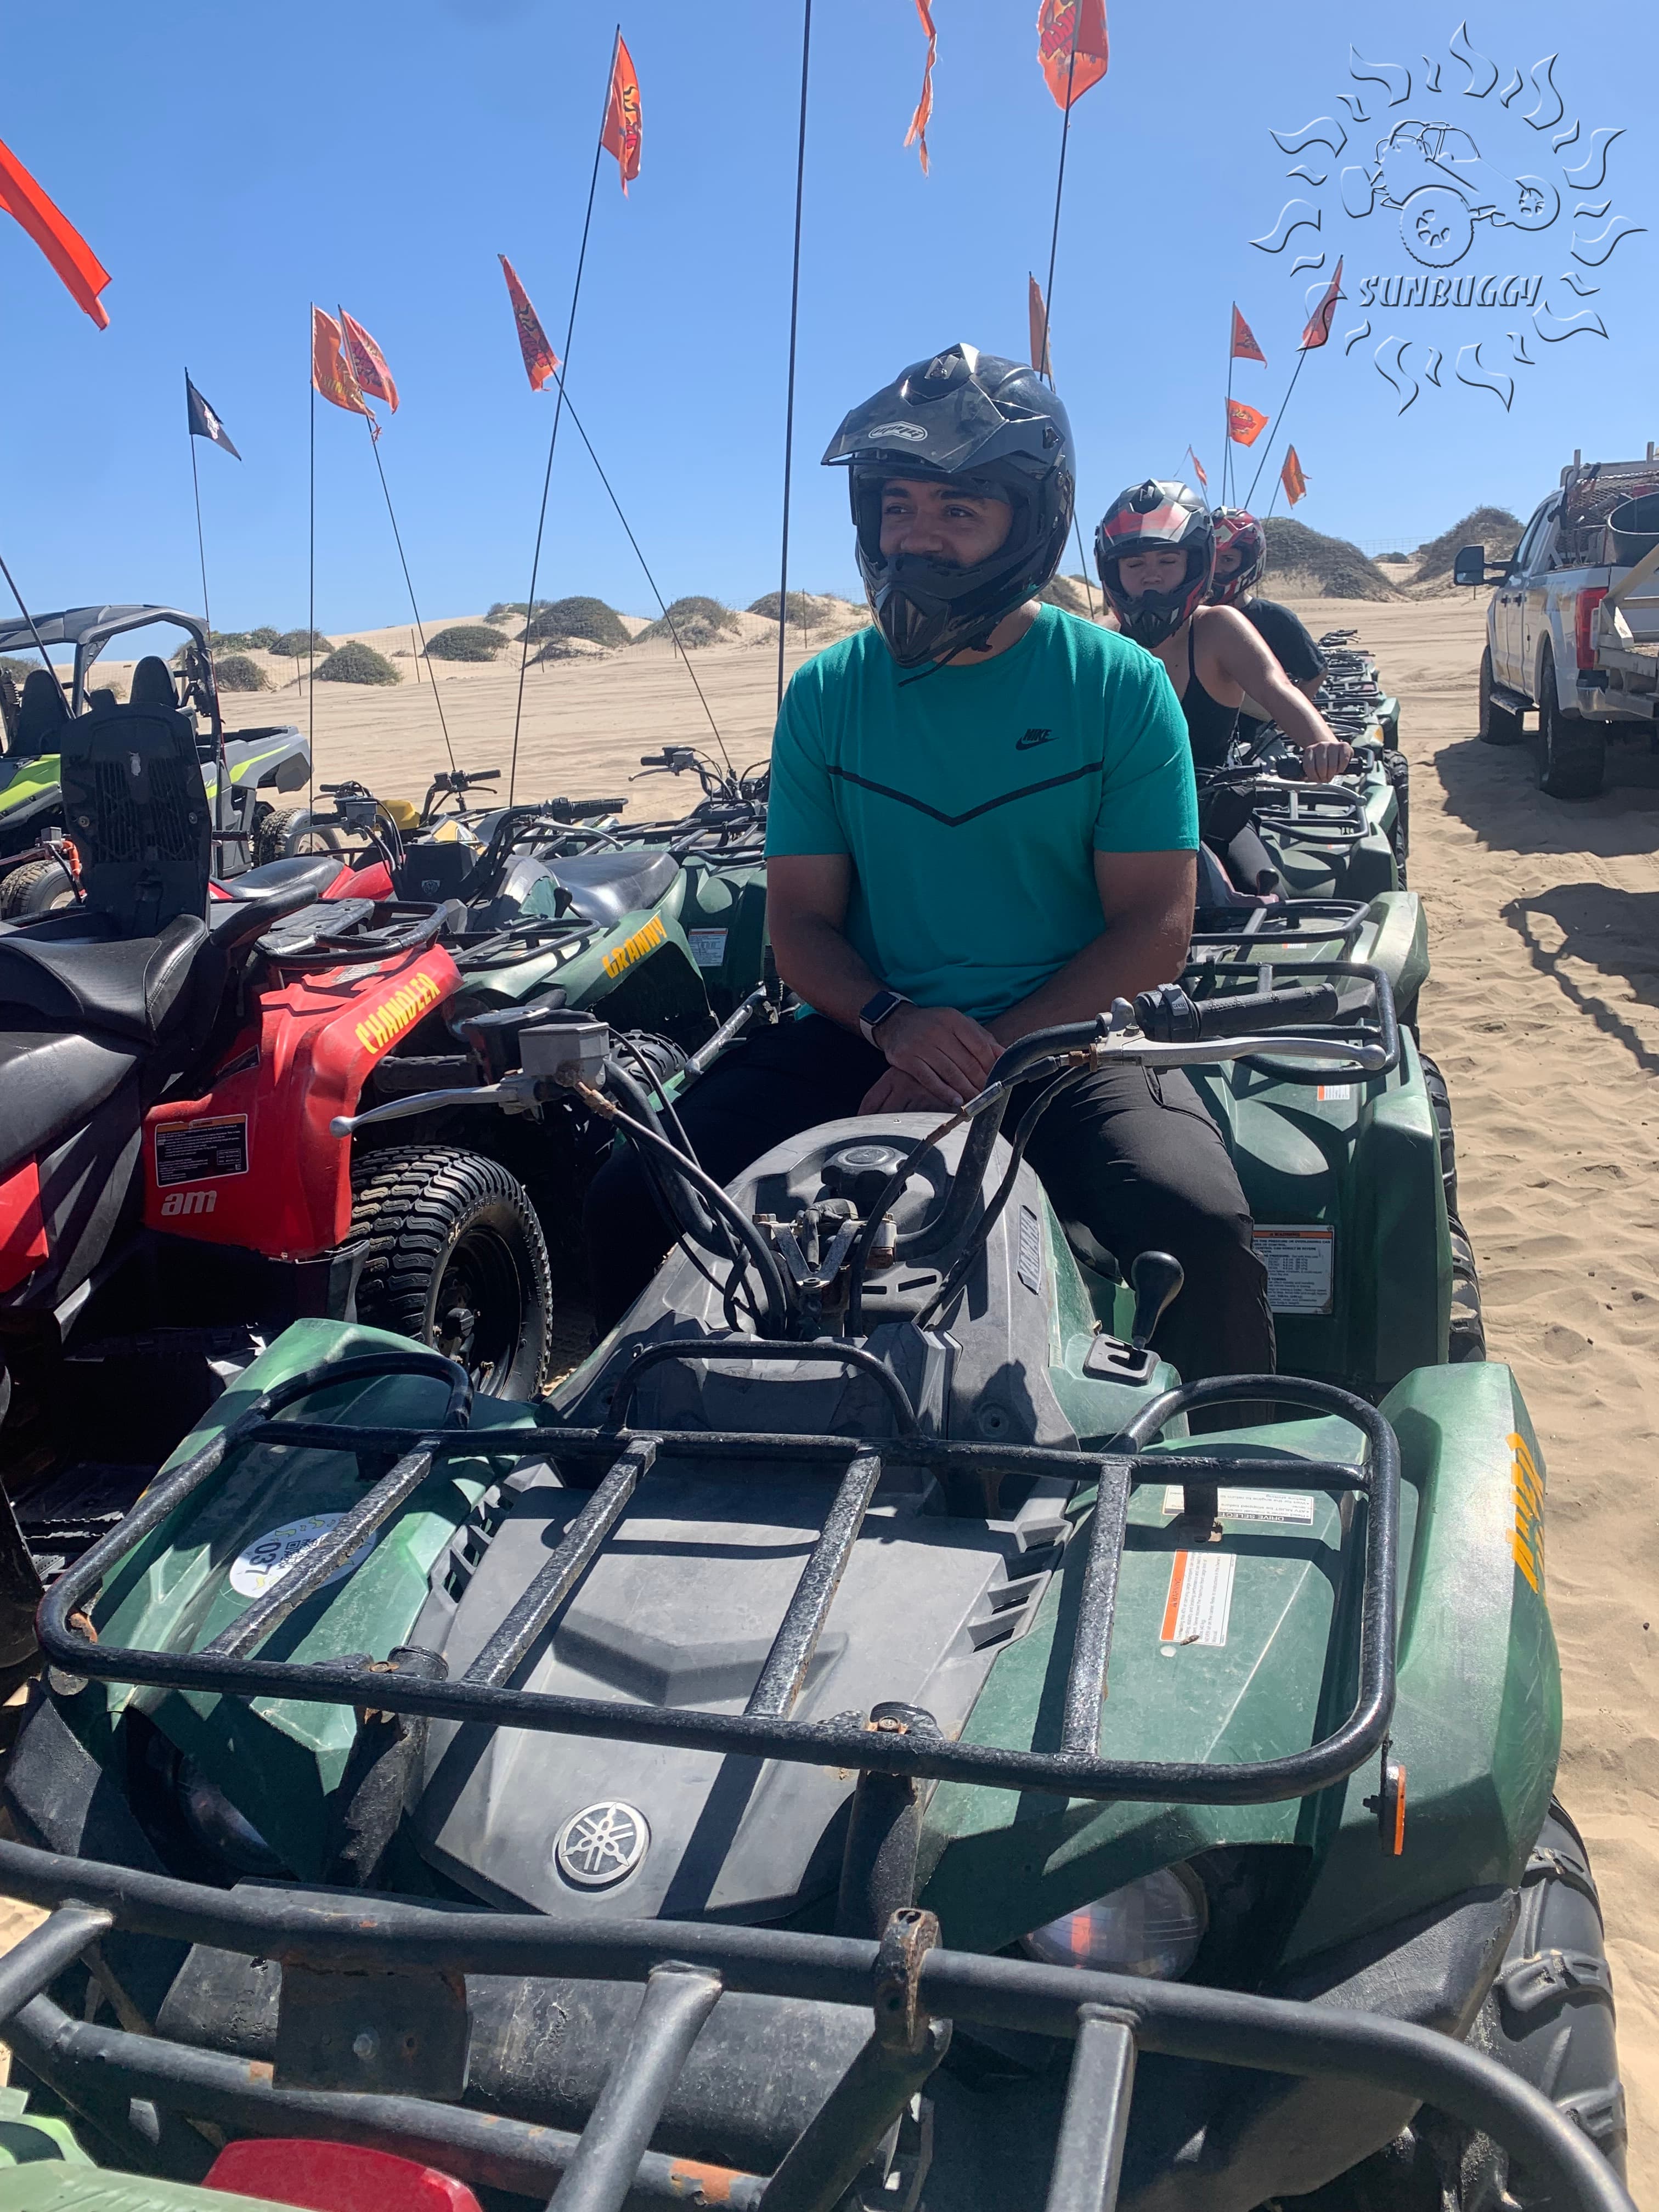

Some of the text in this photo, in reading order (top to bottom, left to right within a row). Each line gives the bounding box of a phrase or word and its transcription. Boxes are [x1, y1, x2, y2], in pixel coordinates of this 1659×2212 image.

[1023, 729, 1052, 741] NIKE
[602, 916, 668, 979] GRANNY
[356, 973, 440, 1054] CHANDLER
[161, 1190, 217, 1216] am
[1020, 1212, 1040, 1283] YAMAHA
[246, 1542, 281, 1575] 037
[1171, 1577, 1181, 1602] WARNING
